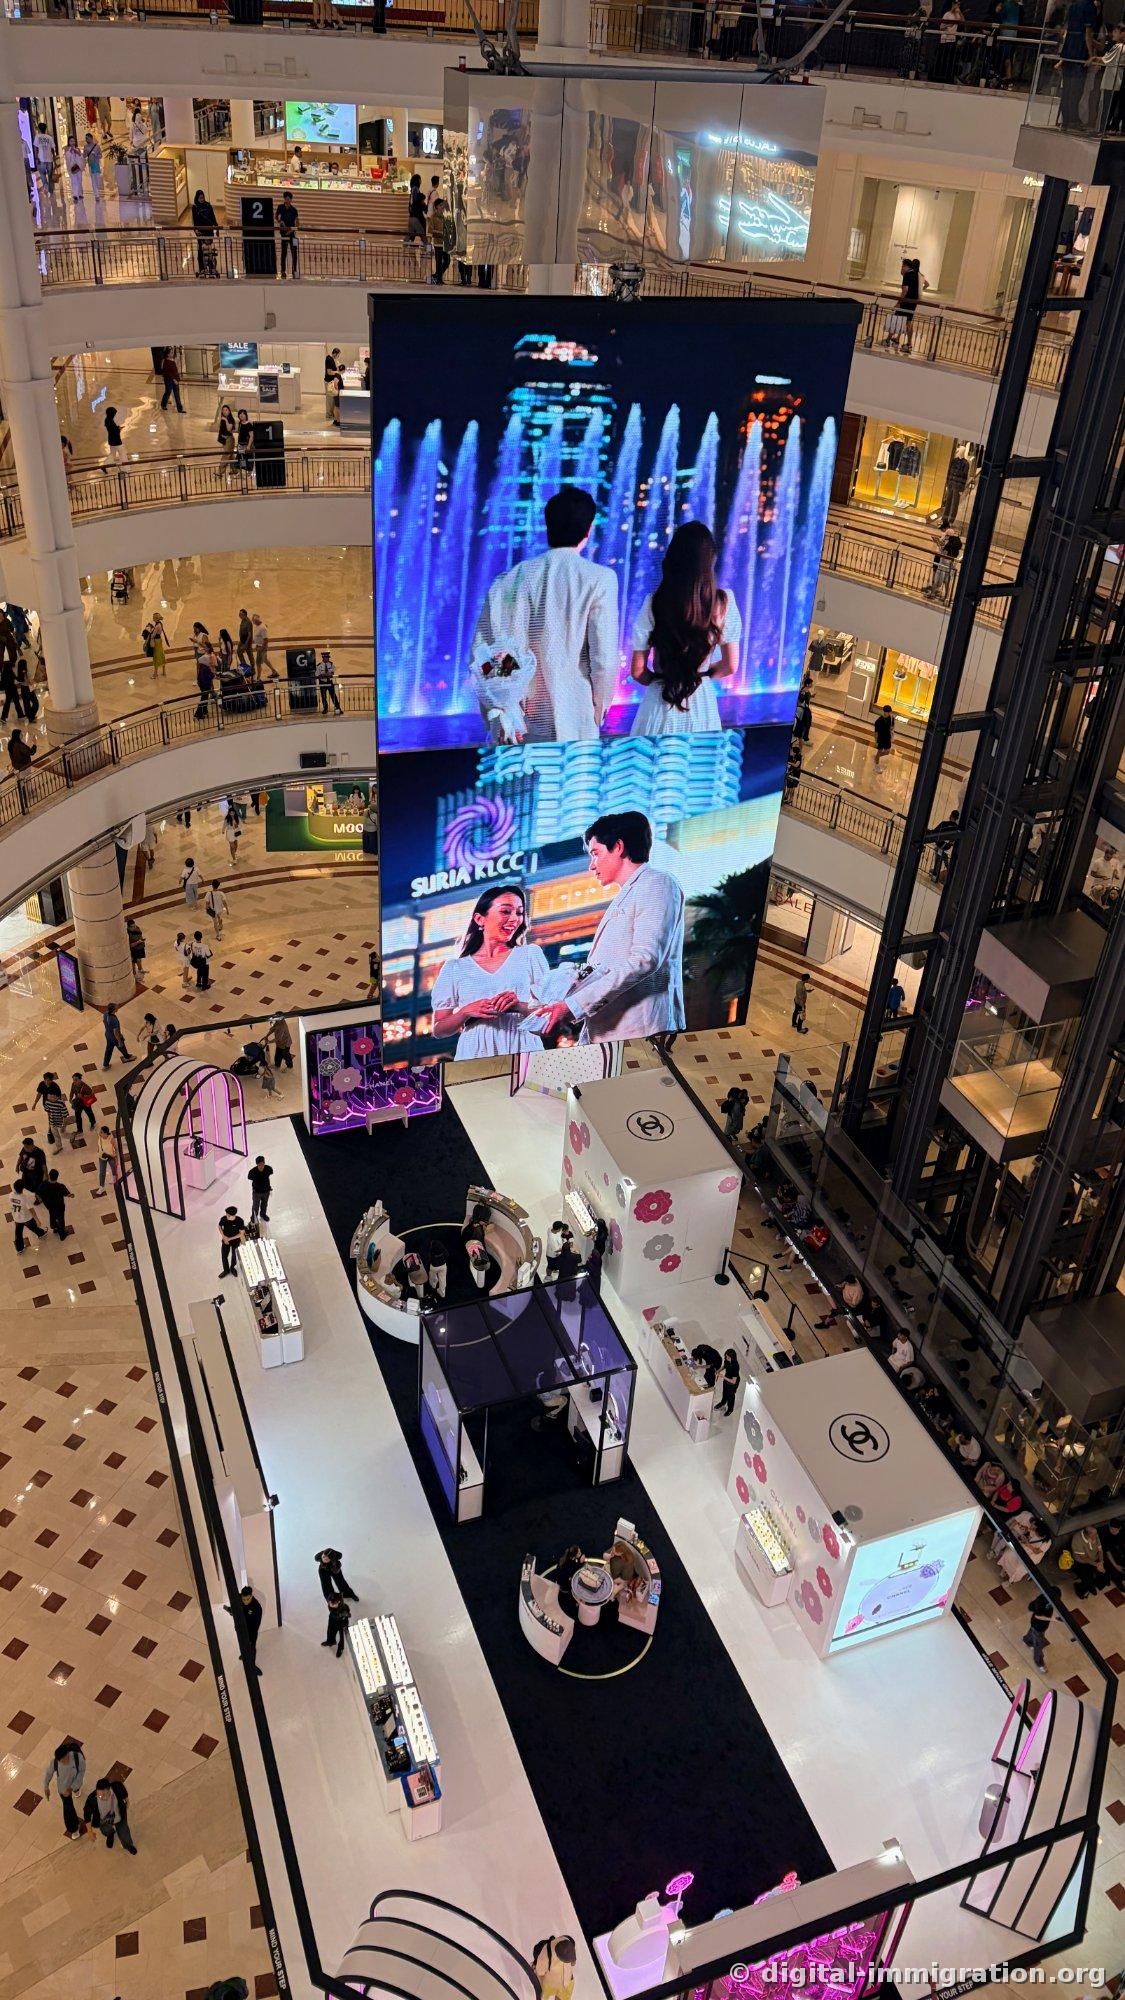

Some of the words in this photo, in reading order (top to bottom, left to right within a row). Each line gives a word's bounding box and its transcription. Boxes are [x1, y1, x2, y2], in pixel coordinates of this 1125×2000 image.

[252, 201, 264, 219] 2
[266, 425, 273, 440] 1
[296, 654, 307, 667] G
[410, 866, 471, 898] SURIA
[474, 851, 526, 880] KLCC
[776, 892, 813, 914] SALE
[224, 1708, 232, 1723] STEP
[269, 1929, 277, 1948] MIND
[273, 1948, 282, 1969] YOUR
[277, 1969, 286, 1990] STEP
[939, 1988, 957, 2000] YOUR
[958, 1981, 974, 1993] STEP
